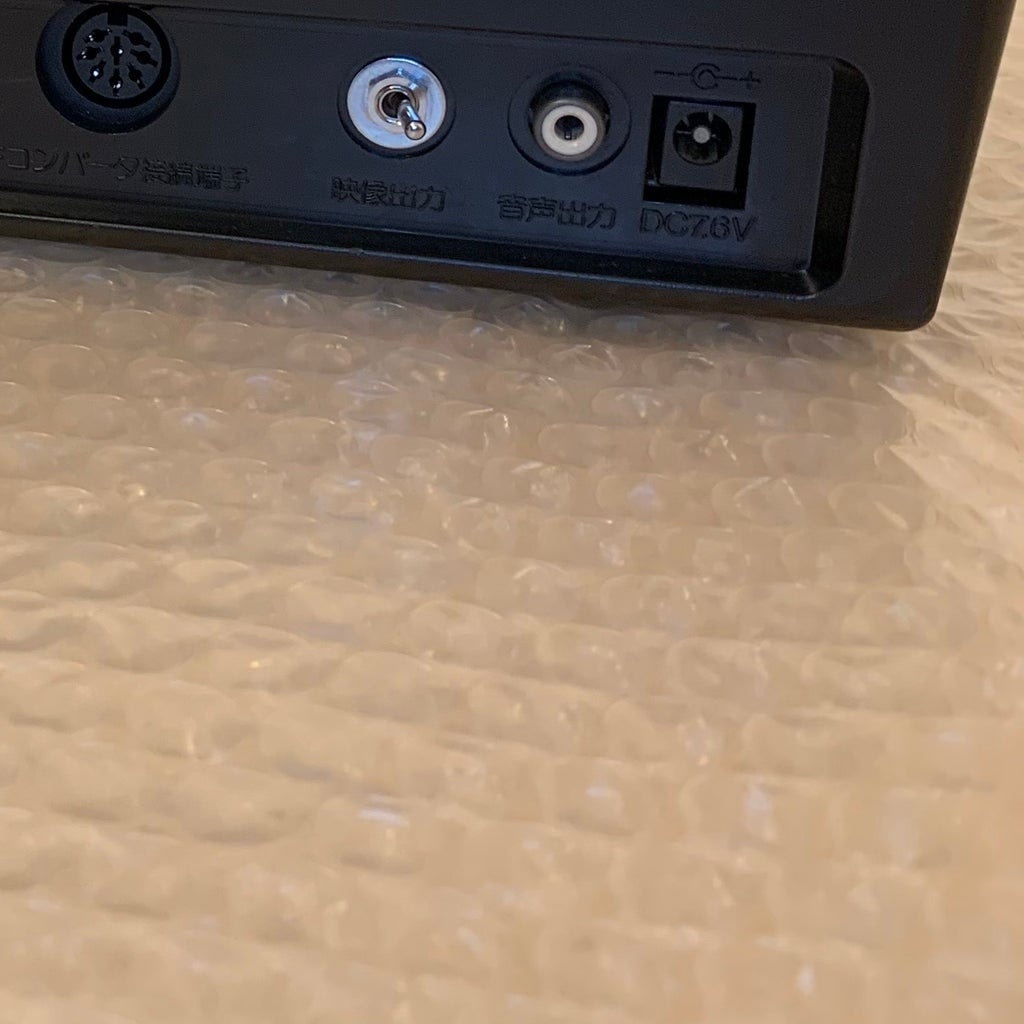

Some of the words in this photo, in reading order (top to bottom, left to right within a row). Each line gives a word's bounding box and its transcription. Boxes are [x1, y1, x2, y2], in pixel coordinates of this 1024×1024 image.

[331, 176, 447, 212] 映像出力
[497, 193, 617, 231] 音声出力
